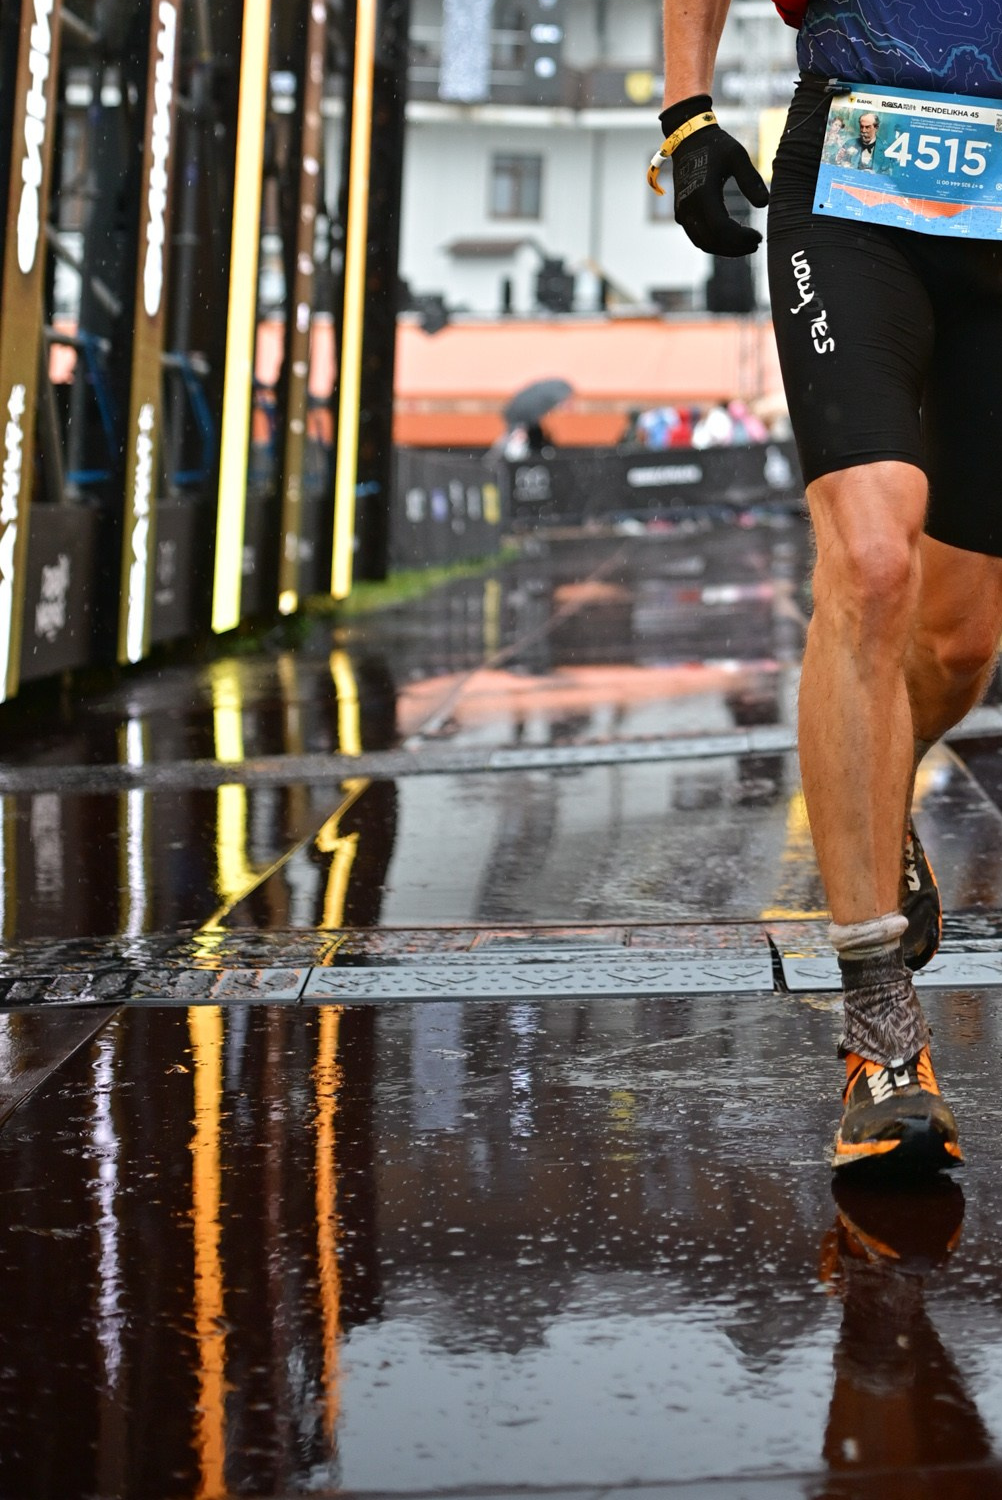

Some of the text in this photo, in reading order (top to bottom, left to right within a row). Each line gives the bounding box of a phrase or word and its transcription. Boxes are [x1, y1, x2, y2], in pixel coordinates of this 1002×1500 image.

[920, 105, 968, 118] MENDELIKHA
[969, 111, 980, 119] 45
[884, 131, 987, 176] 4515
